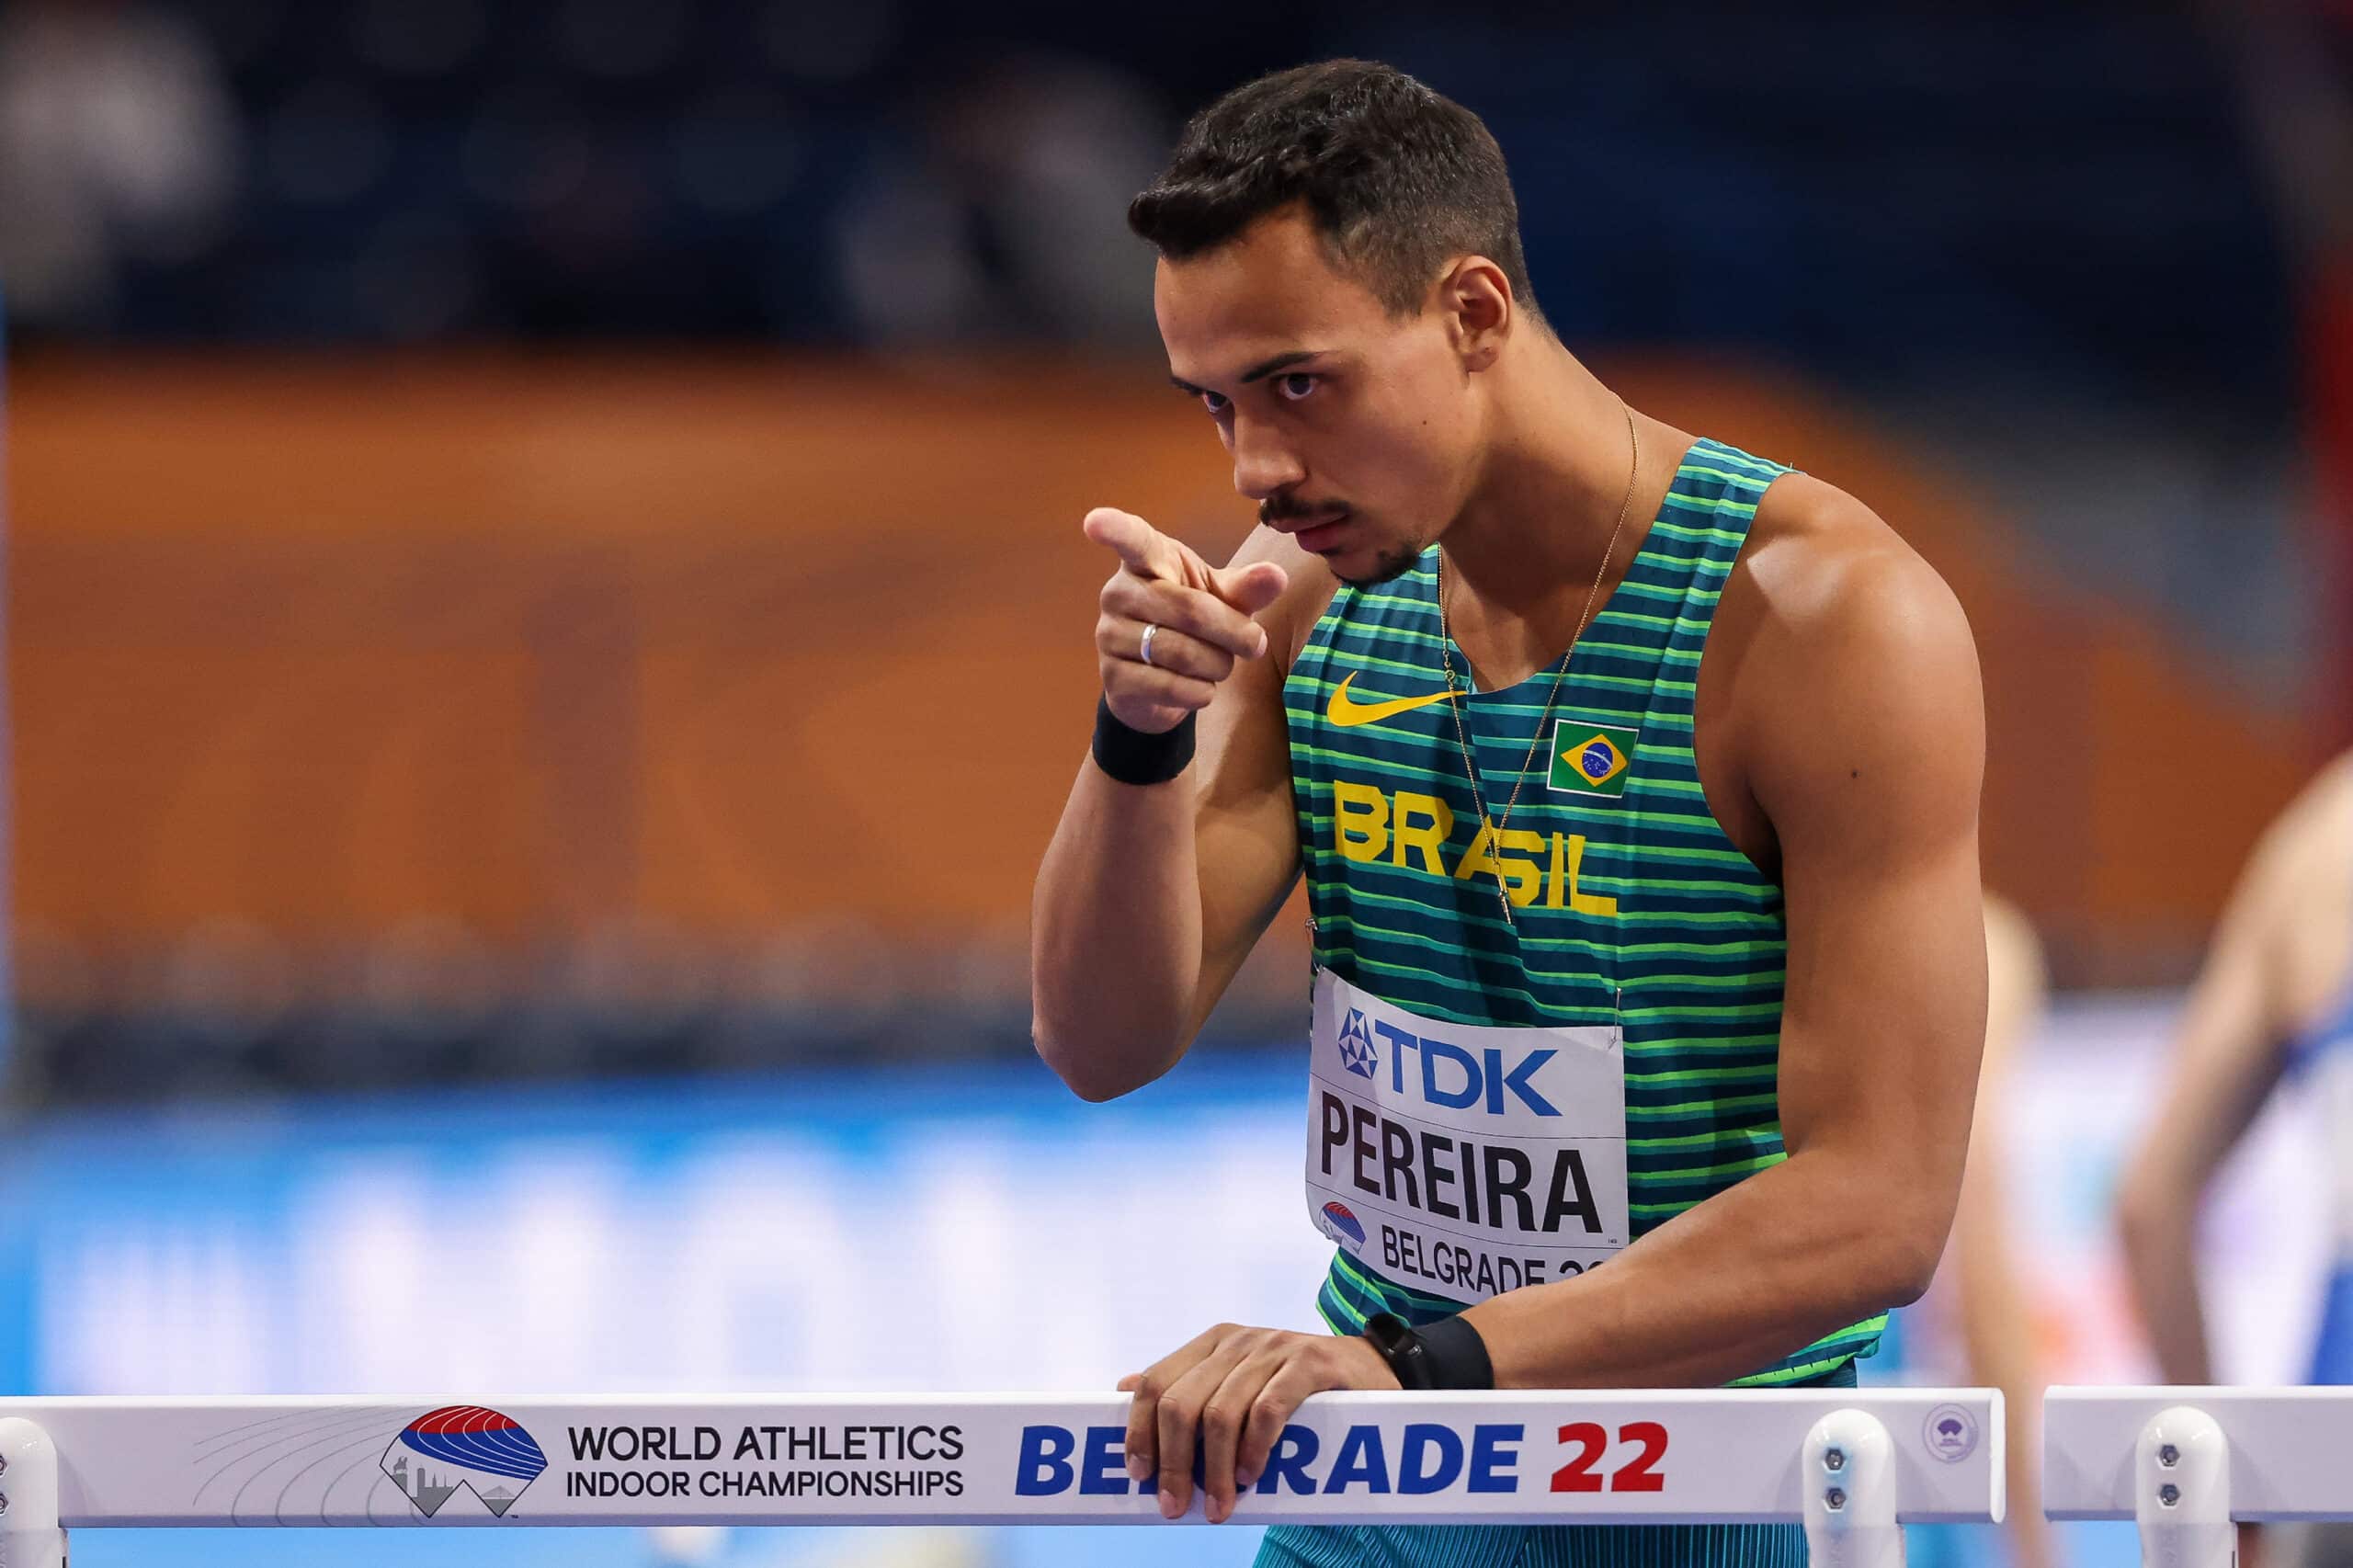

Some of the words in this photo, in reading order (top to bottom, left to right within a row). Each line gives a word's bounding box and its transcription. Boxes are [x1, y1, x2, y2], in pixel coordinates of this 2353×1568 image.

[1334, 779, 1618, 917] BRASIL
[1375, 1019, 1563, 1117] TDK
[1321, 1090, 1604, 1234] PEREIRA
[1381, 1224, 1545, 1297] BELGRADE
[567, 1426, 722, 1461] WORLD
[733, 1426, 964, 1461] ATHLETICS
[1015, 1424, 1525, 1496] BERADE
[1550, 1422, 1668, 1493] 22
[566, 1471, 691, 1497] INDOOR
[699, 1471, 964, 1497] CHAMPIONSHIPS
